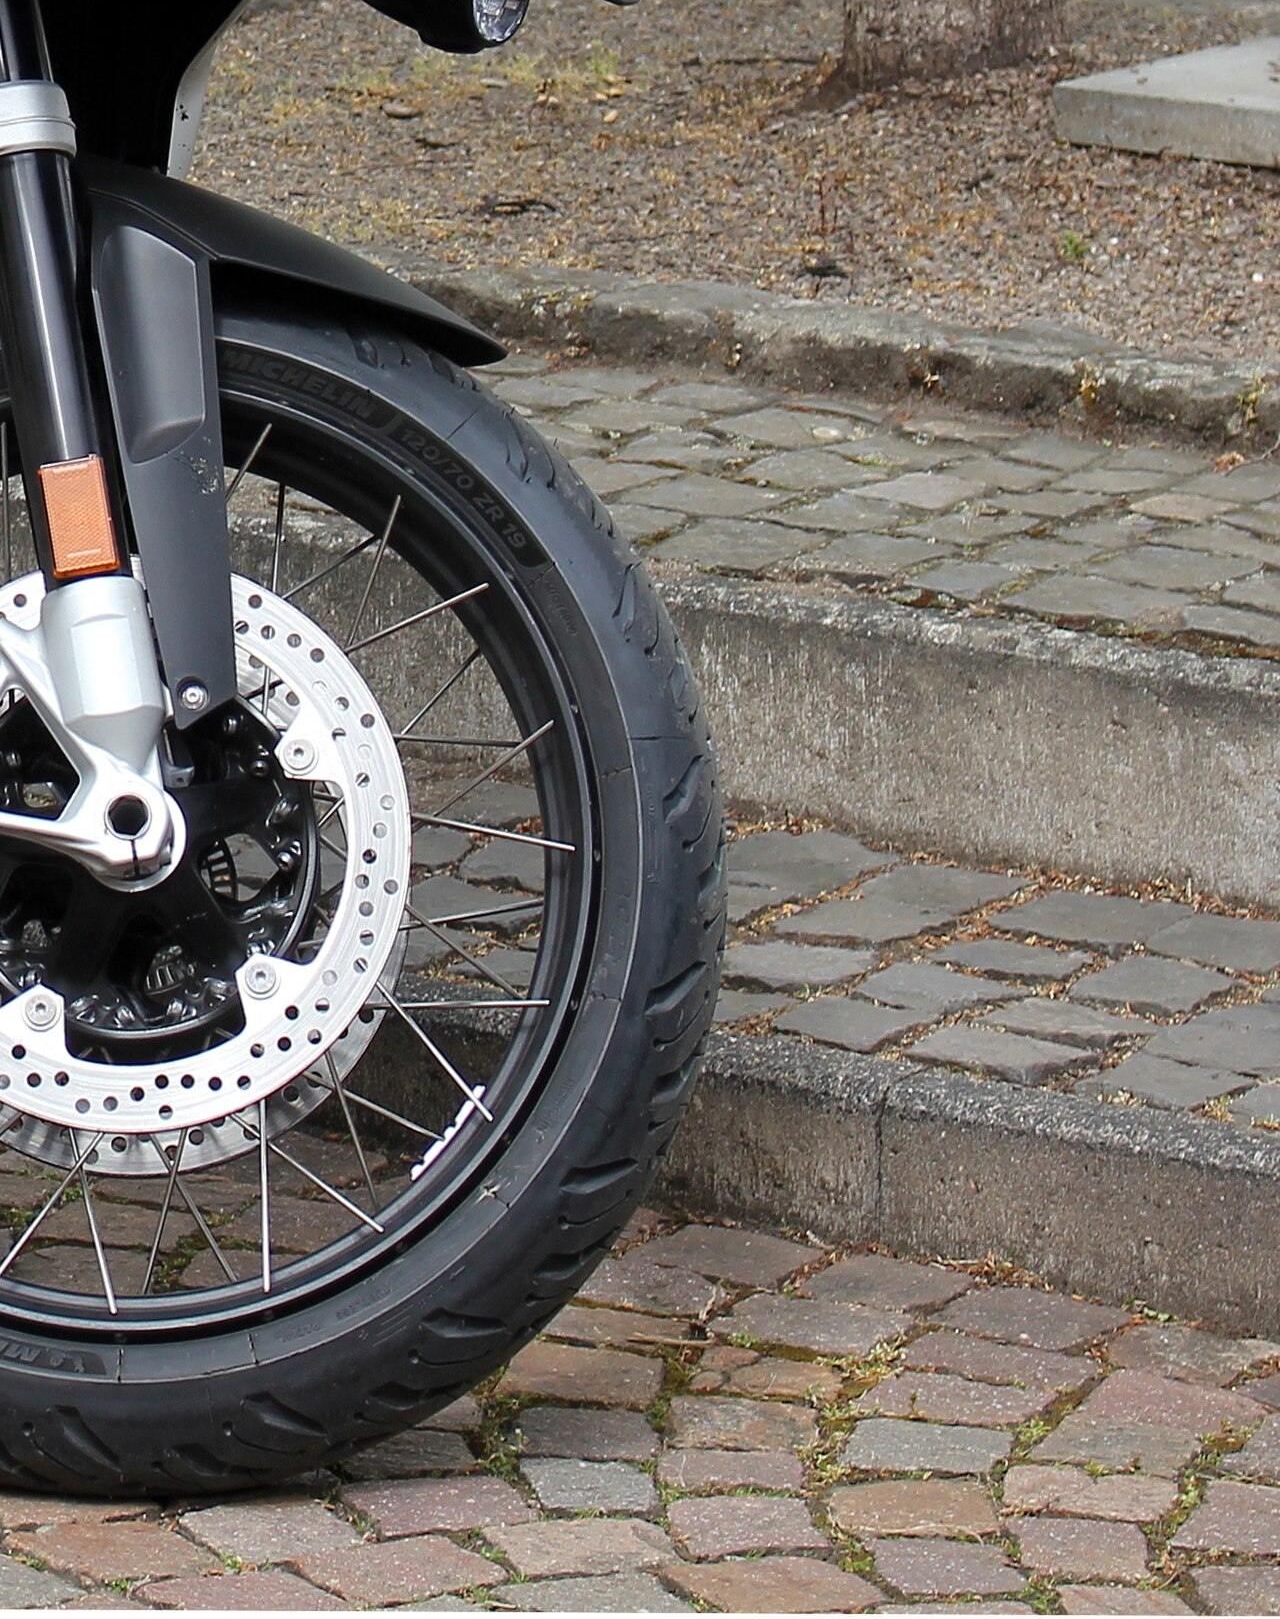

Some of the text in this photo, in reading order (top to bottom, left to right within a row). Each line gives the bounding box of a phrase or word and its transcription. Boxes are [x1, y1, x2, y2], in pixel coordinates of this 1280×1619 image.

[220, 347, 529, 550] MICHELIN 120/70 ZR 19
